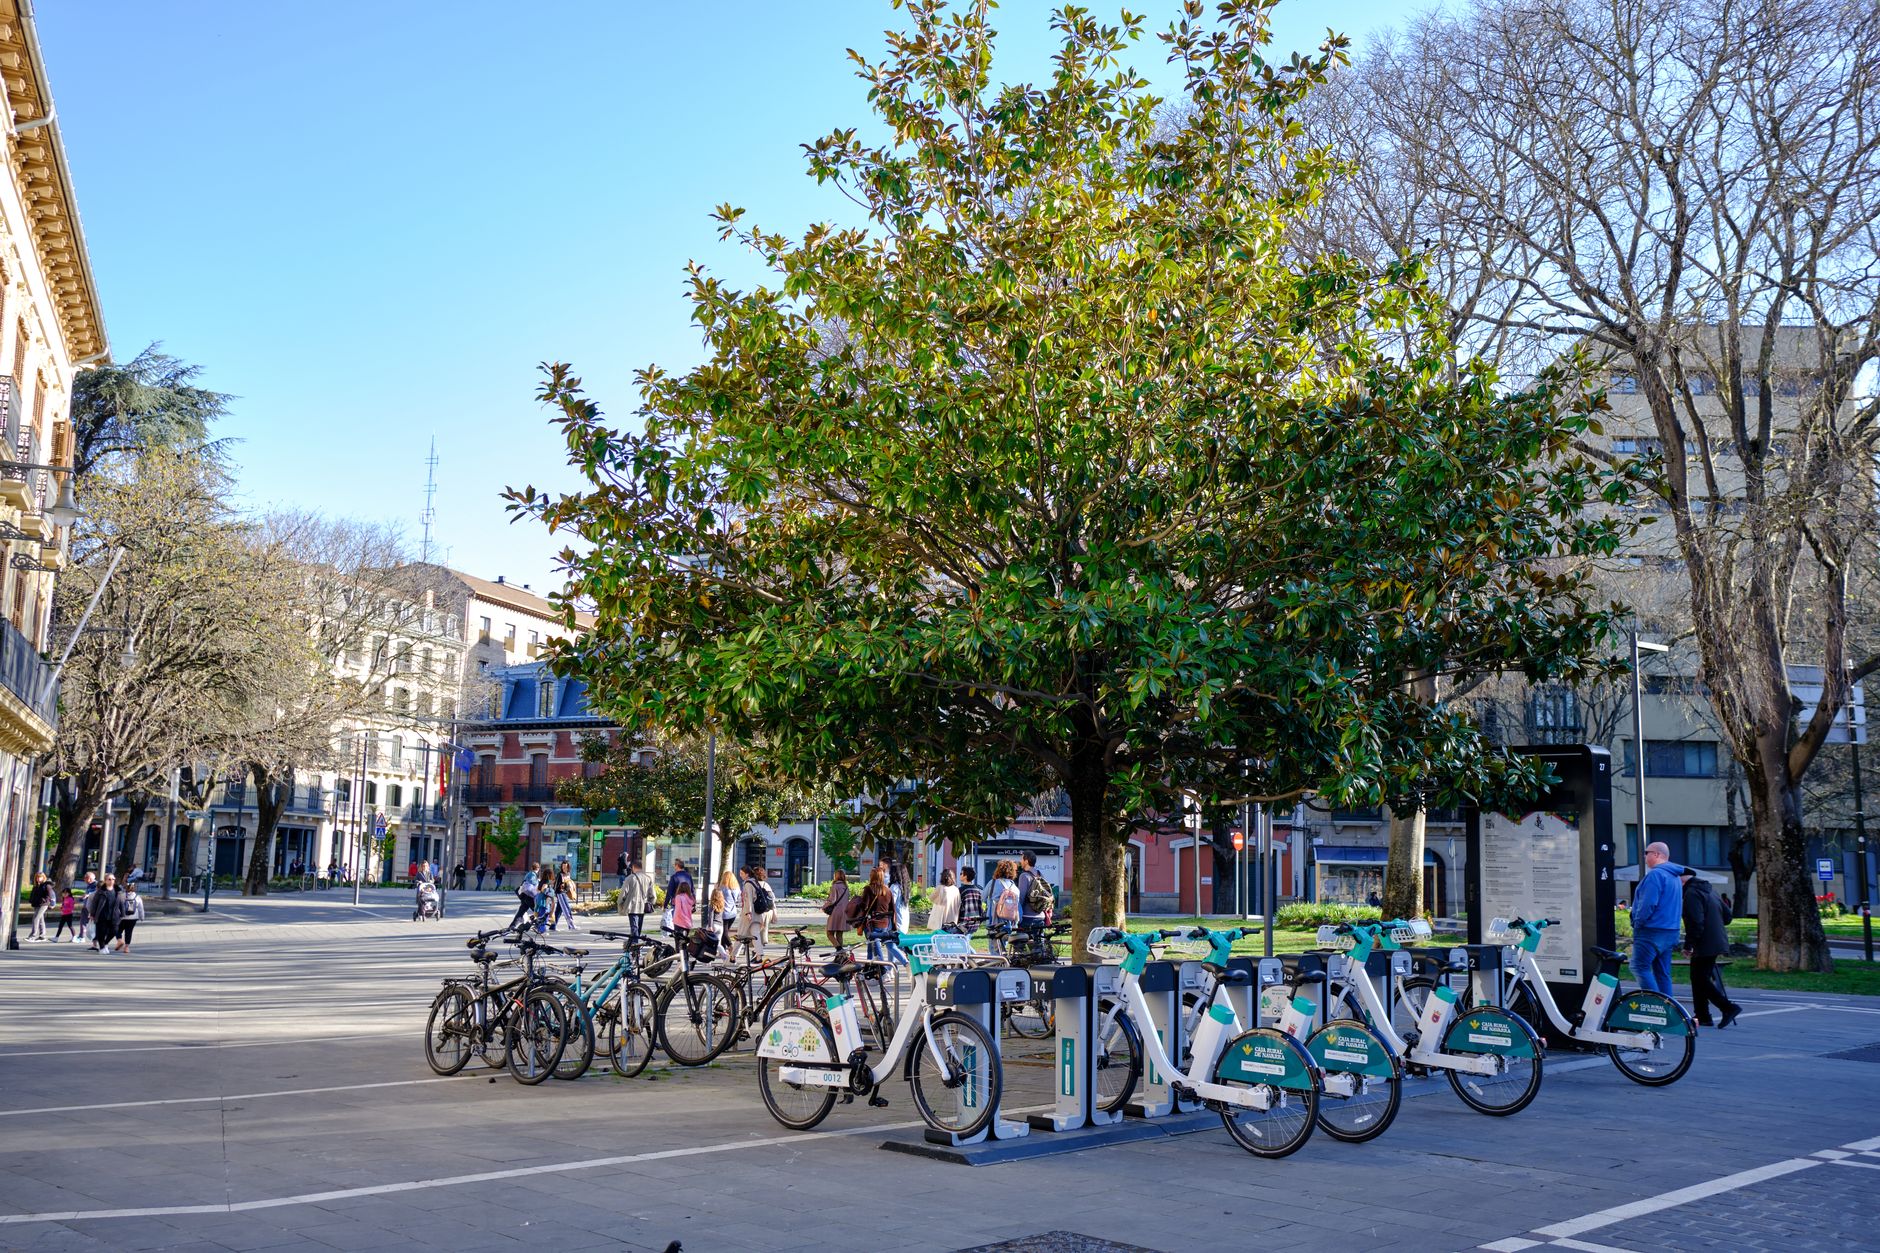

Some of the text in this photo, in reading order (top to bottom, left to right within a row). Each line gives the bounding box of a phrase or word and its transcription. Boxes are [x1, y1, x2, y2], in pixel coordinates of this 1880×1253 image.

[1599, 763, 1605, 771] 27
[1034, 981, 1046, 993] 14
[934, 987, 947, 1001] 16
[823, 1073, 842, 1082] 0012
